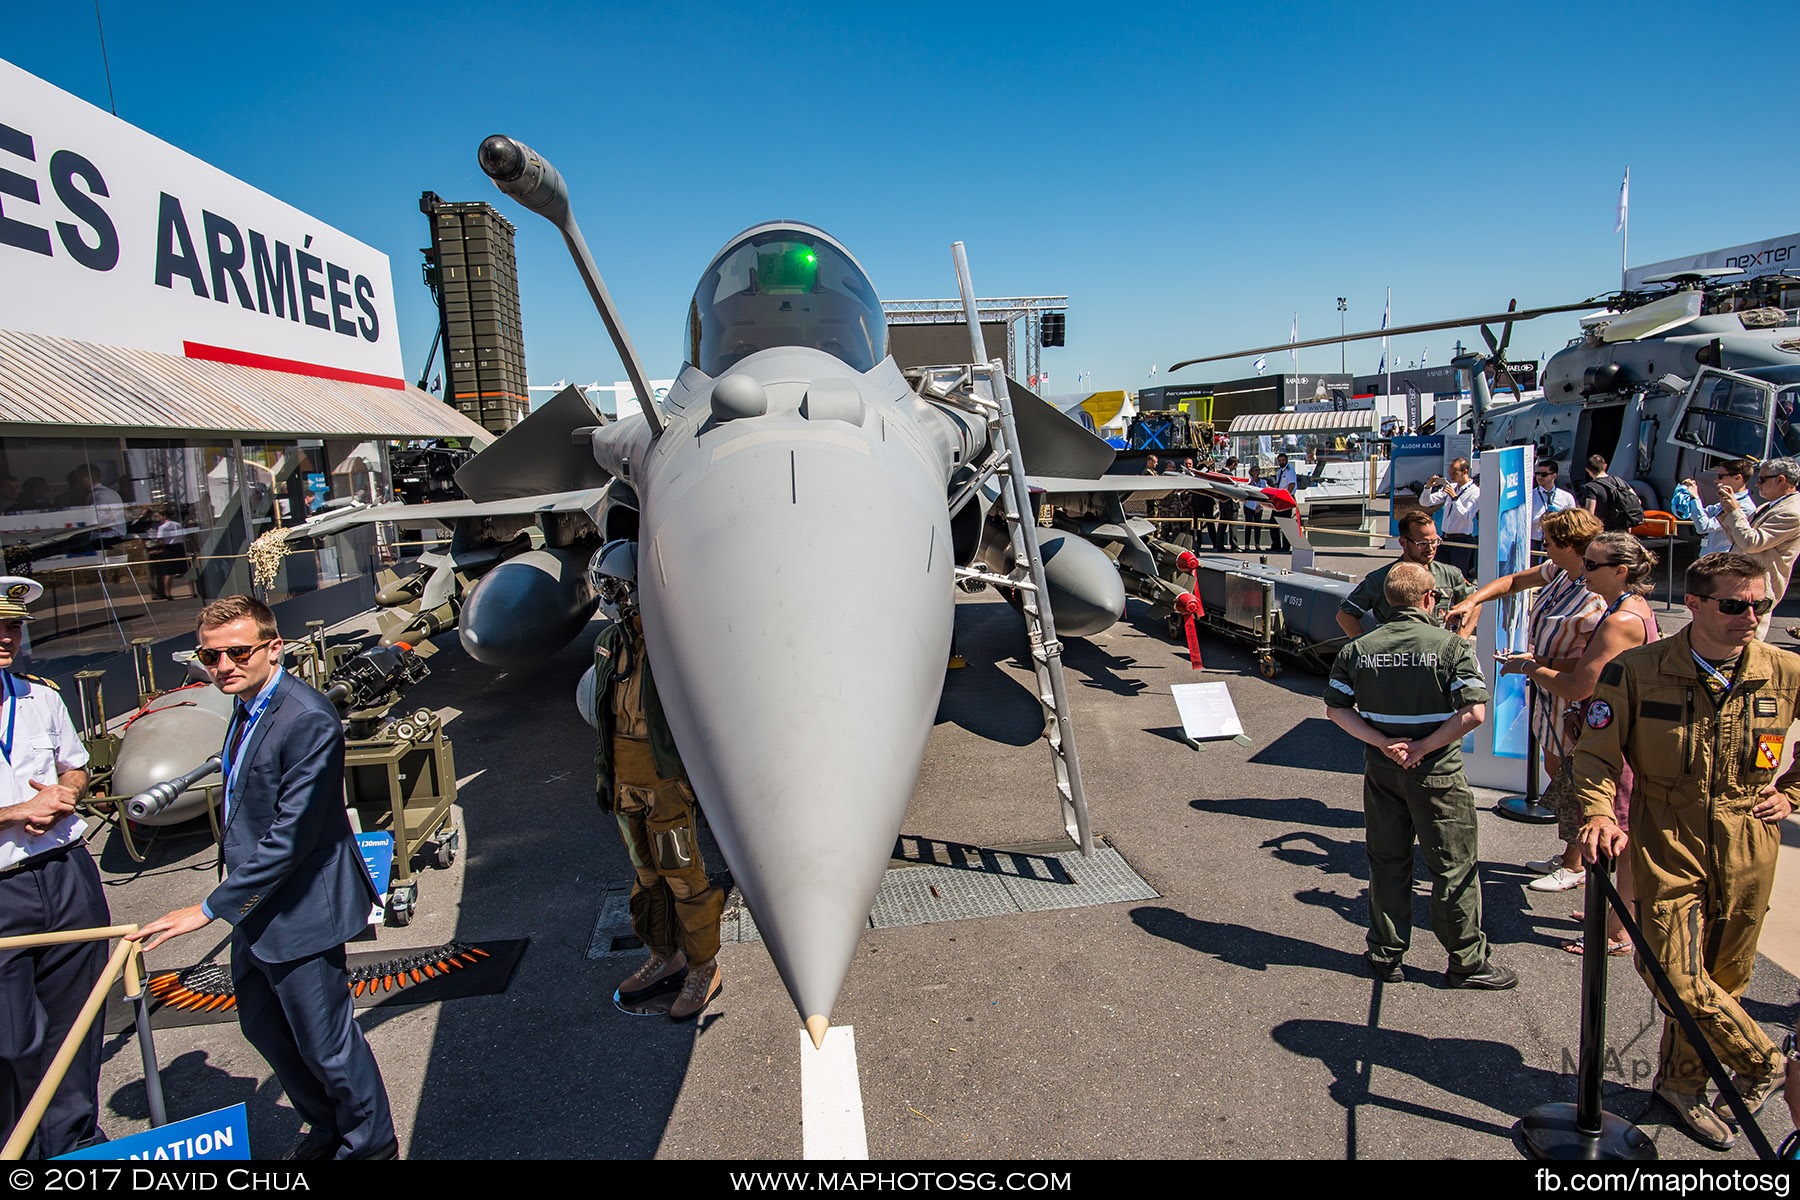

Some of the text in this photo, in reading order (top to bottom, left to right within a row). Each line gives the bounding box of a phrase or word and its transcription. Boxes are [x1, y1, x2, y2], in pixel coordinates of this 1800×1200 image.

[155, 191, 379, 342] ARMÉES
[1355, 652, 1437, 668] ARMEE DE L'AIR
[362, 839, 389, 847] (30mm)
